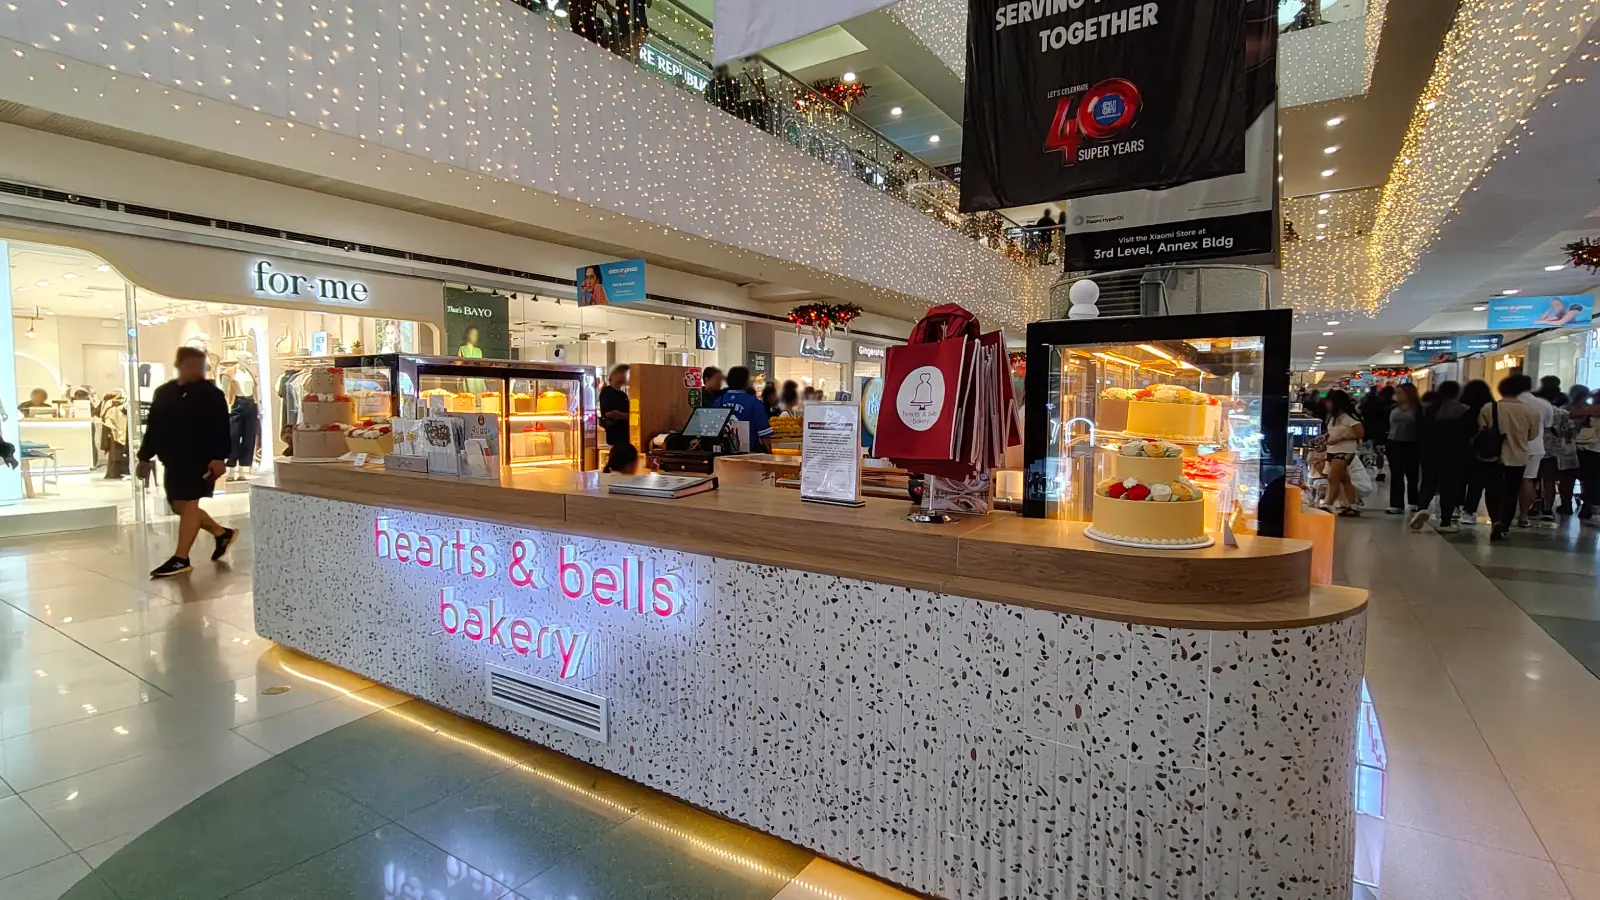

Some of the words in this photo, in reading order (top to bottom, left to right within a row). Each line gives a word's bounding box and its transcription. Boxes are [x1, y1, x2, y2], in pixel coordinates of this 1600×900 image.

[1038, 2, 1159, 53] TOGETHER
[1047, 89, 1061, 99] LET'S
[1061, 83, 1089, 95] CELEBRATE
[1078, 145, 1110, 161] SUPER
[1112, 139, 1145, 156] YEARS
[1118, 236, 1135, 244] Visit
[1135, 234, 1148, 242] the
[1149, 231, 1175, 241] Xiaomi
[1176, 229, 1197, 238] Store
[1198, 228, 1206, 236] at
[1094, 247, 1114, 260] 3rd
[1117, 242, 1154, 257] Level,
[1157, 240, 1198, 253] Annex
[1202, 235, 1234, 249] Bldg
[463, 306, 492, 318] BAYO
[699, 320, 716, 336] BA
[699, 334, 716, 349] YO
[374, 516, 492, 578] hearts
[507, 539, 544, 589] &
[559, 545, 680, 617] bells
[439, 586, 588, 680] bakery
